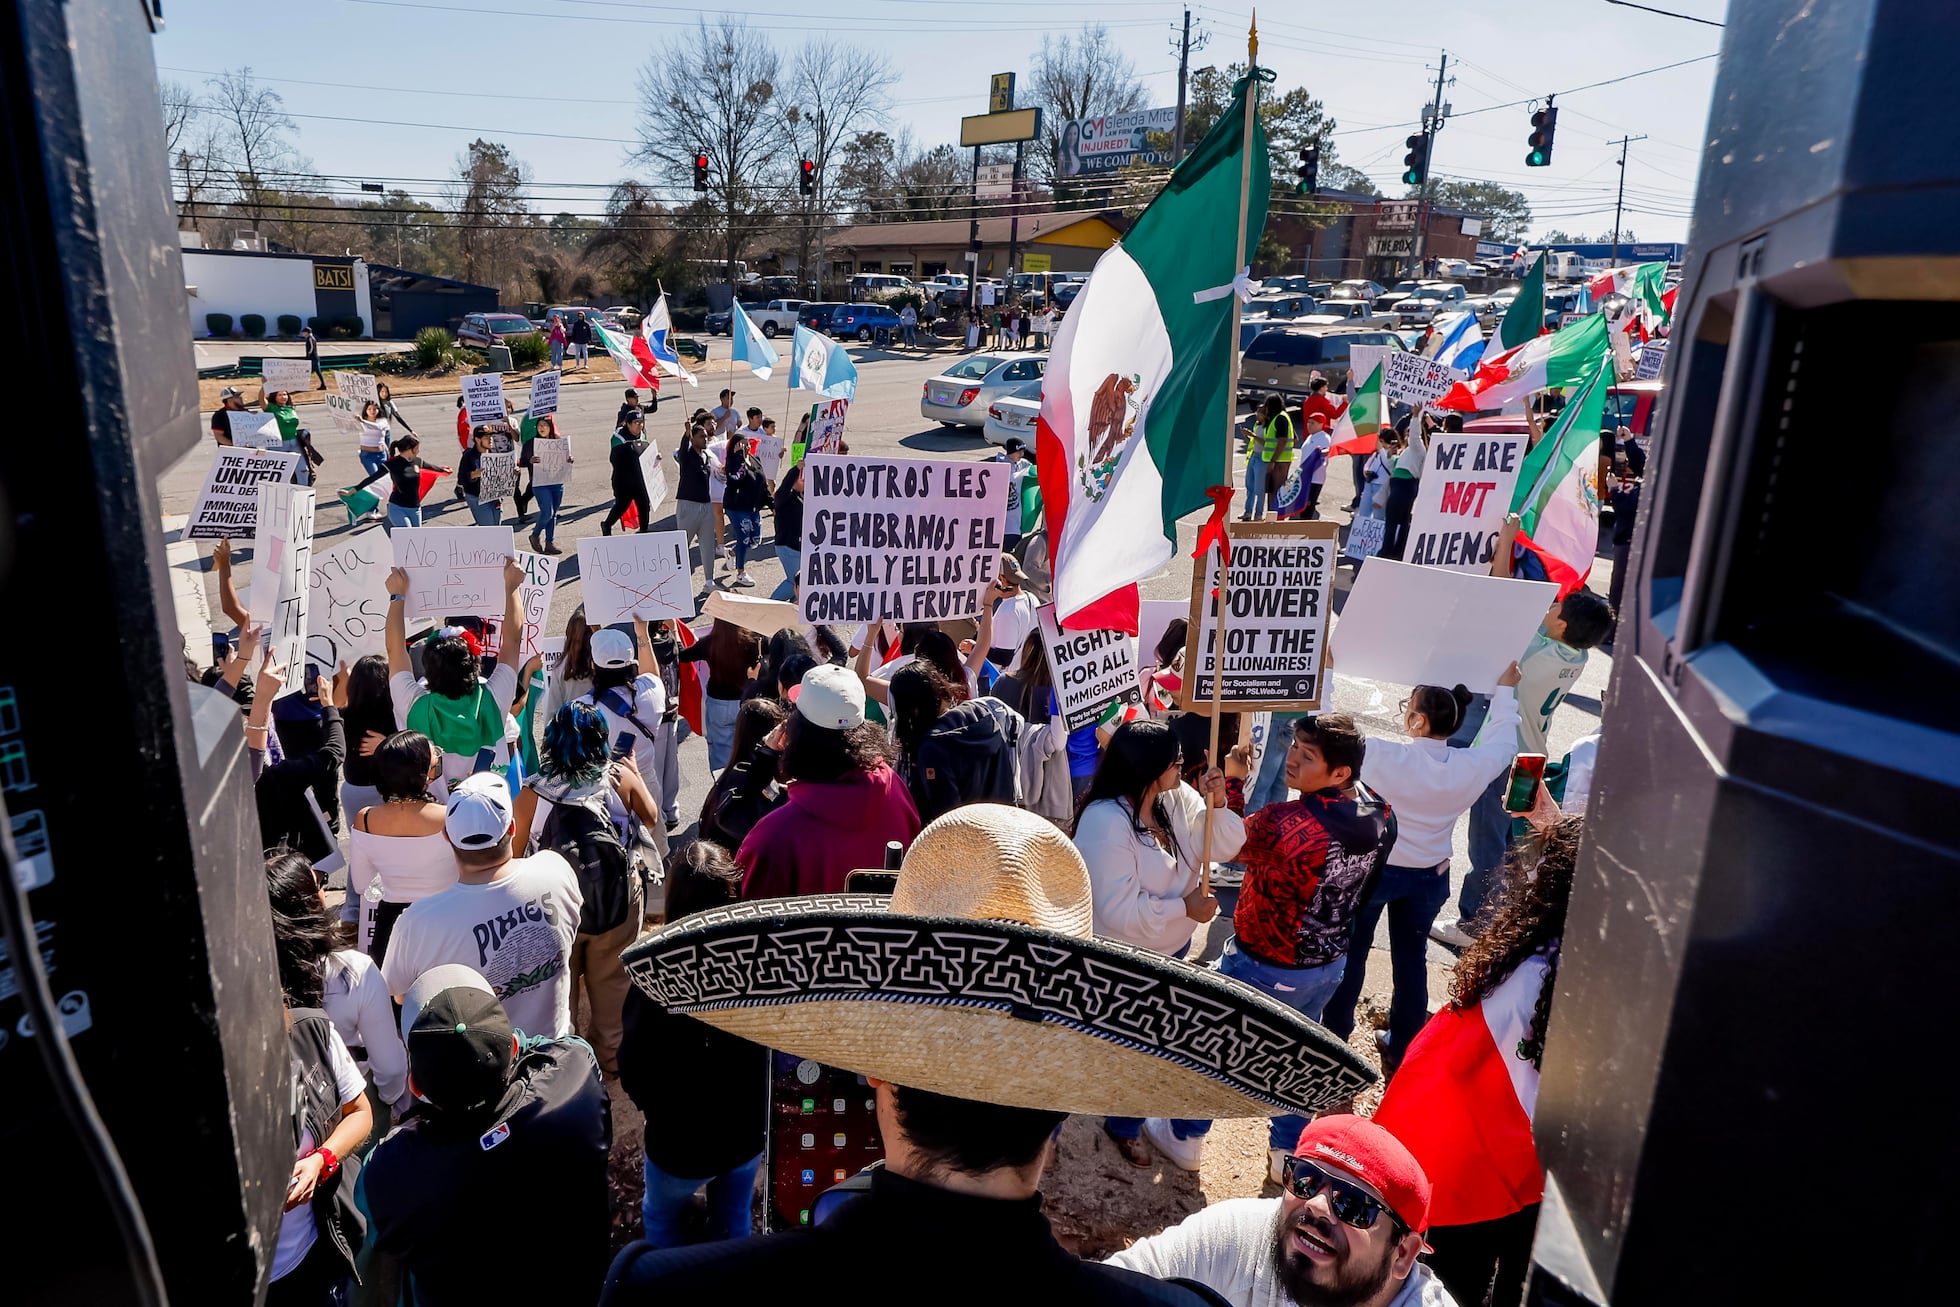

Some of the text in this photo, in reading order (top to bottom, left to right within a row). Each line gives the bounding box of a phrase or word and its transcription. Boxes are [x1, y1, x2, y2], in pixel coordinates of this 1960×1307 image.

[1105, 109, 1177, 129] Glenda Mitc
[1118, 128, 1133, 136] FIRM
[1080, 138, 1129, 153] INJURED?
[1086, 158, 1102, 169] WE
[1141, 152, 1155, 163] TO
[1158, 151, 1173, 163] YO
[1377, 239, 1412, 252] THE BOX
[1391, 360, 1424, 377] PADRES
[1426, 371, 1439, 382] NO
[1396, 352, 1449, 376] NUESTROS
[474, 378, 490, 387] U.S.
[1384, 379, 1399, 389] POR
[1386, 368, 1447, 392] CRIMINALES
[326, 394, 337, 408] NO
[337, 396, 352, 412] ONE
[471, 400, 487, 408] FOR
[1387, 388, 1404, 400] UNA
[221, 456, 288, 471] THE PEOPLE
[1436, 441, 1518, 473] WE ARE
[215, 467, 282, 486] UNITED
[812, 463, 992, 500] NOSOTROS LES
[210, 484, 235, 495] WILL
[1440, 481, 1497, 518] NOT
[203, 500, 259, 512] IMMIGRA
[809, 509, 1000, 551] SEMBRAMOS EL
[405, 535, 506, 568] No Human
[1216, 545, 1325, 568] WORKERS
[1410, 531, 1500, 566] ALIENS
[588, 544, 682, 581] Abolish!
[884, 554, 899, 586] Y
[901, 554, 964, 586] ELLOS
[968, 554, 993, 584] SE
[1212, 570, 1323, 587] SHOULD HAVE
[417, 586, 486, 610] Illegal
[615, 582, 677, 610] ICE
[805, 591, 875, 623] COMEN
[880, 590, 905, 620] LA
[1267, 628, 1316, 654] THE
[1062, 648, 1130, 690] FOR ALL
[1204, 656, 1312, 671] BLLIONAIRES!
[1065, 669, 1136, 708] IMMIGRANTS
[1222, 679, 1232, 687] for
[1233, 679, 1267, 688] Socialism
[1267, 679, 1281, 687] and
[1245, 687, 1289, 697] PSLWeb.org
[472, 891, 559, 968] PIXIES
